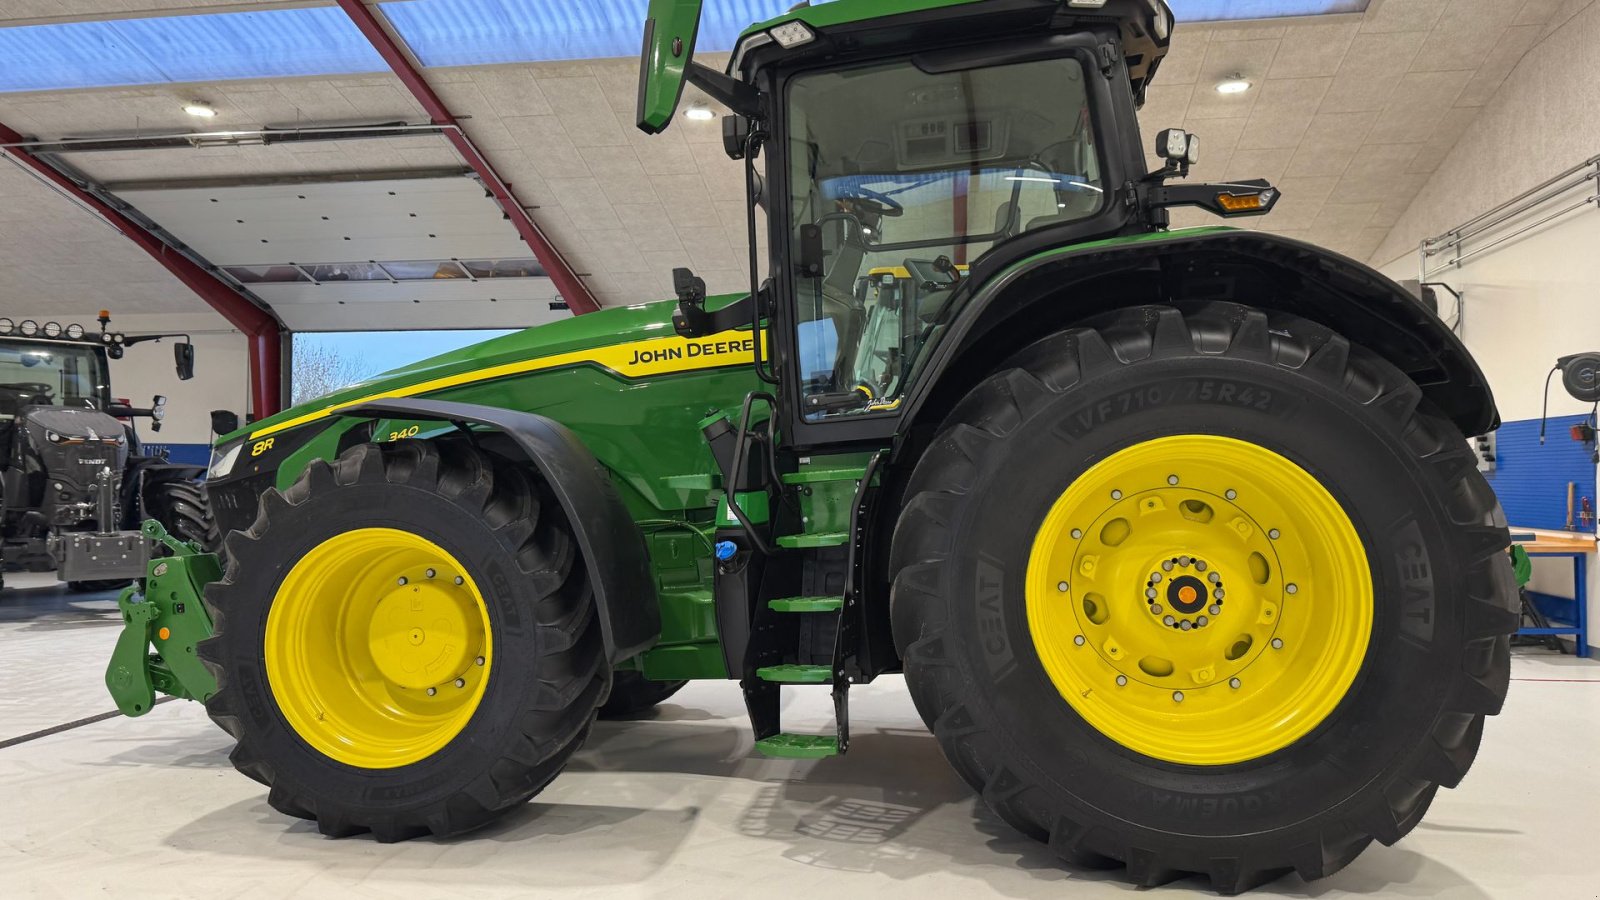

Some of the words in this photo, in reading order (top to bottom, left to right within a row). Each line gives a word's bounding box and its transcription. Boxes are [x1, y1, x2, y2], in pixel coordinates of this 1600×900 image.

[629, 347, 682, 365] JOHN
[687, 339, 754, 357] DEERE
[388, 425, 419, 442] 340
[251, 437, 275, 457] 8R
[1401, 541, 1430, 624] CEAT
[979, 576, 1006, 655] CEAT
